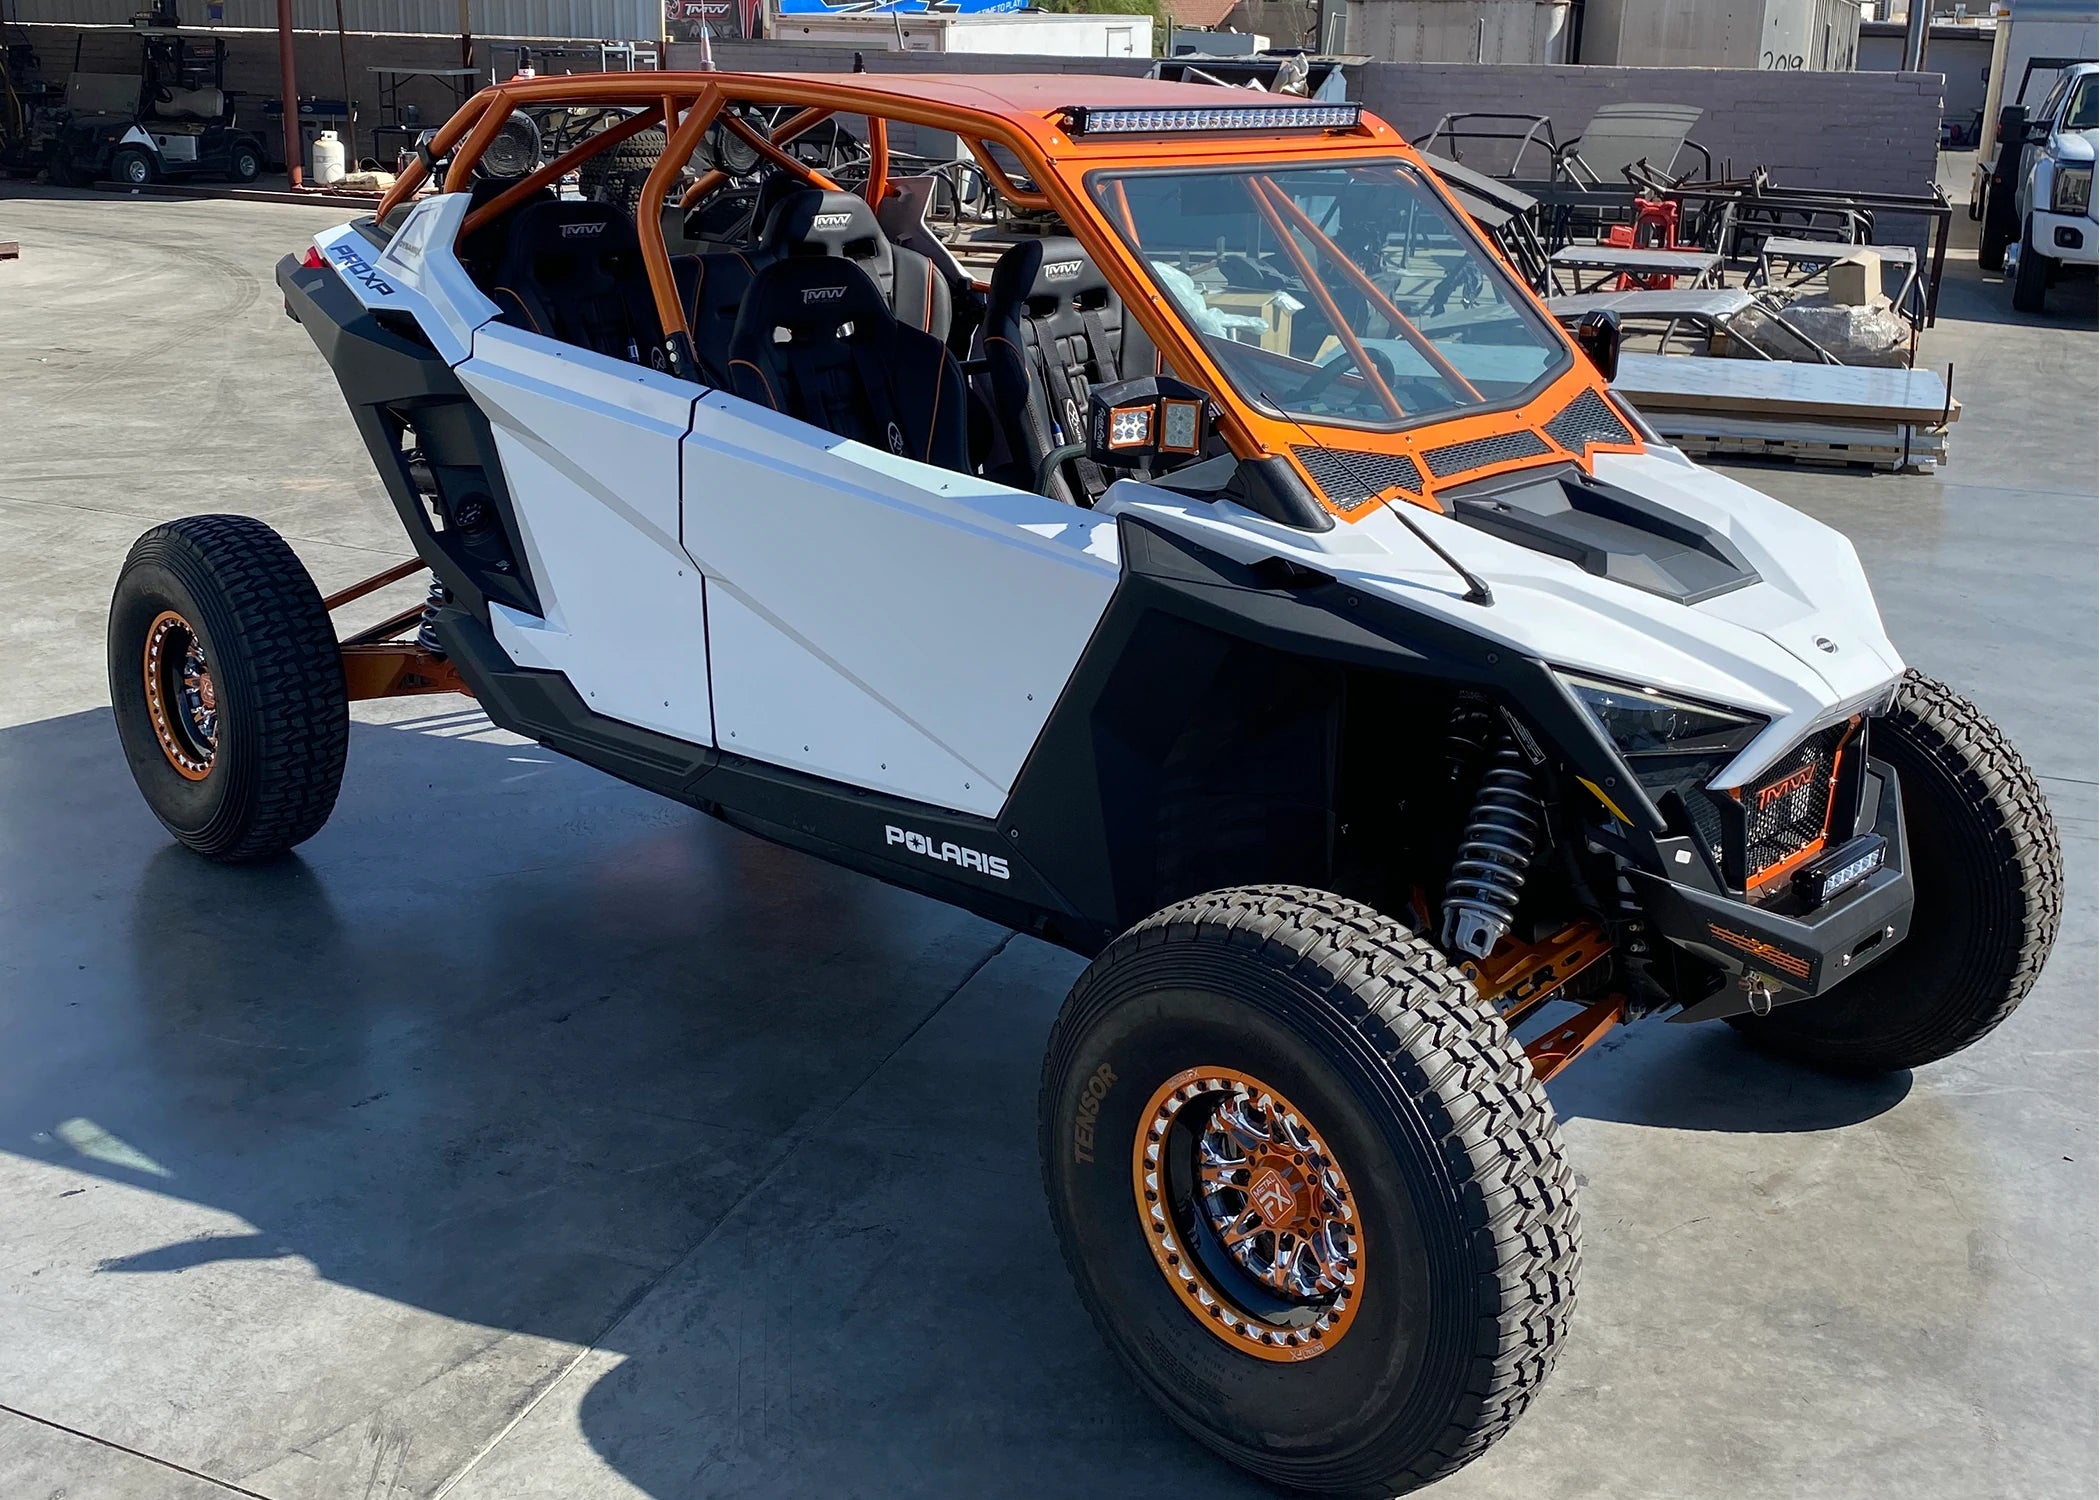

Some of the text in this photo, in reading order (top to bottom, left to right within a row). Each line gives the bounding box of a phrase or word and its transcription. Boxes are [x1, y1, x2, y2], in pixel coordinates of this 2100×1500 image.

[684, 4, 729, 15] TMW
[1763, 50, 1804, 70] 2019
[559, 222, 607, 238] TMW
[814, 213, 852, 228] TMW
[1043, 260, 1083, 278] TMW
[801, 286, 848, 304] TMW
[1757, 763, 1816, 810] TMW
[885, 825, 1010, 880] POLARIS
[1492, 964, 1559, 1016] HCR
[1074, 1063, 1119, 1164] TENSOR
[1253, 1177, 1276, 1198] METAL
[1259, 1183, 1291, 1220] FX
